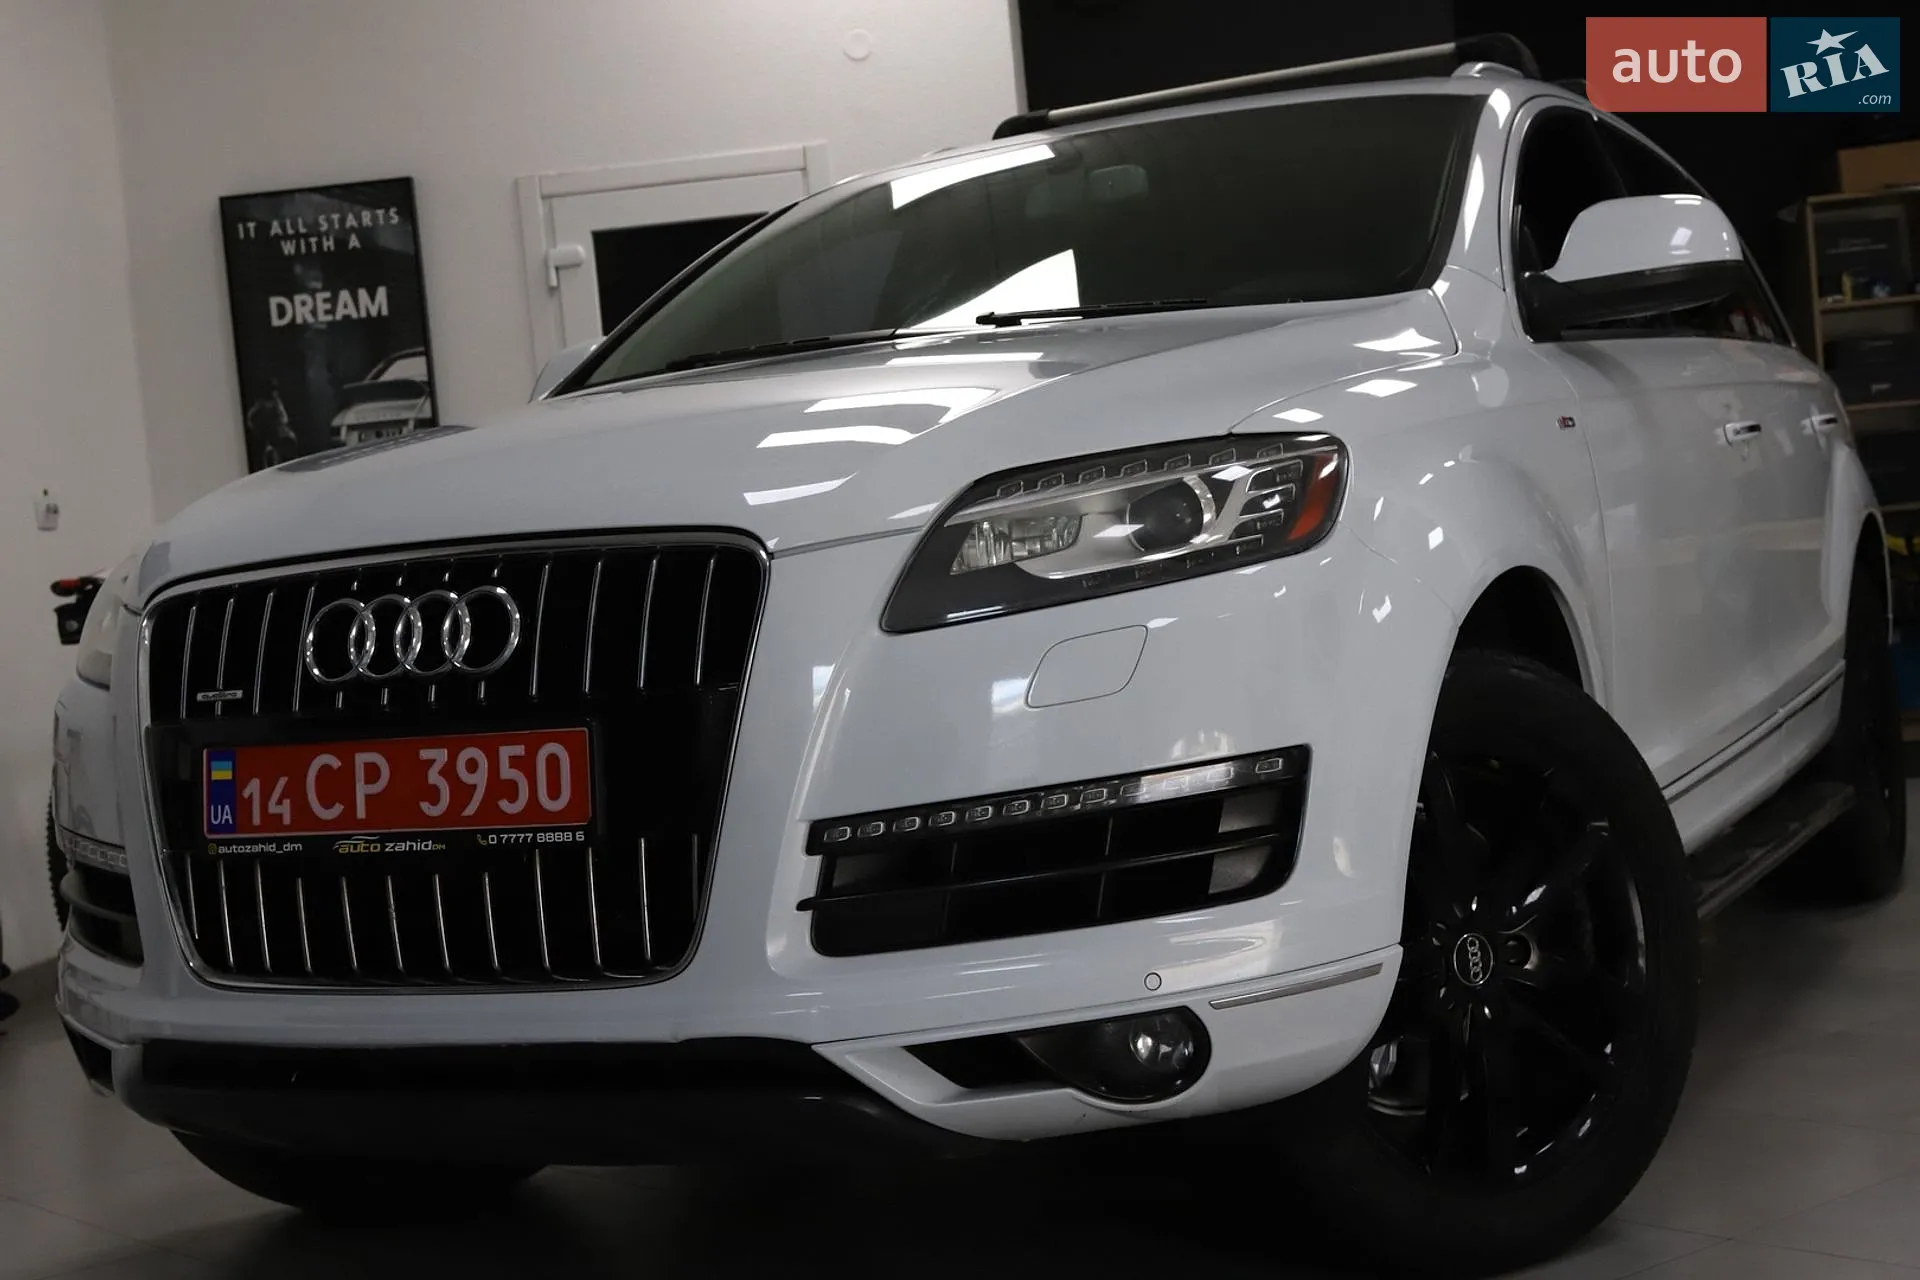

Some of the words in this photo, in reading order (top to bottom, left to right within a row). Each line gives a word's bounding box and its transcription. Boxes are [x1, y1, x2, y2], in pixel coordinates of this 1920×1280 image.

[237, 221, 256, 240] IT
[269, 217, 308, 237] ALL
[317, 207, 400, 233] STARTS
[280, 235, 335, 256] WITH
[348, 232, 361, 250] A
[268, 285, 389, 327] DREAM
[241, 776, 292, 827] 14
[305, 751, 391, 821] CP
[418, 742, 572, 818] 3950
[210, 804, 233, 825] UA
[338, 841, 381, 854] auto
[500, 833, 533, 844] 7777
[536, 831, 573, 843] 8888
